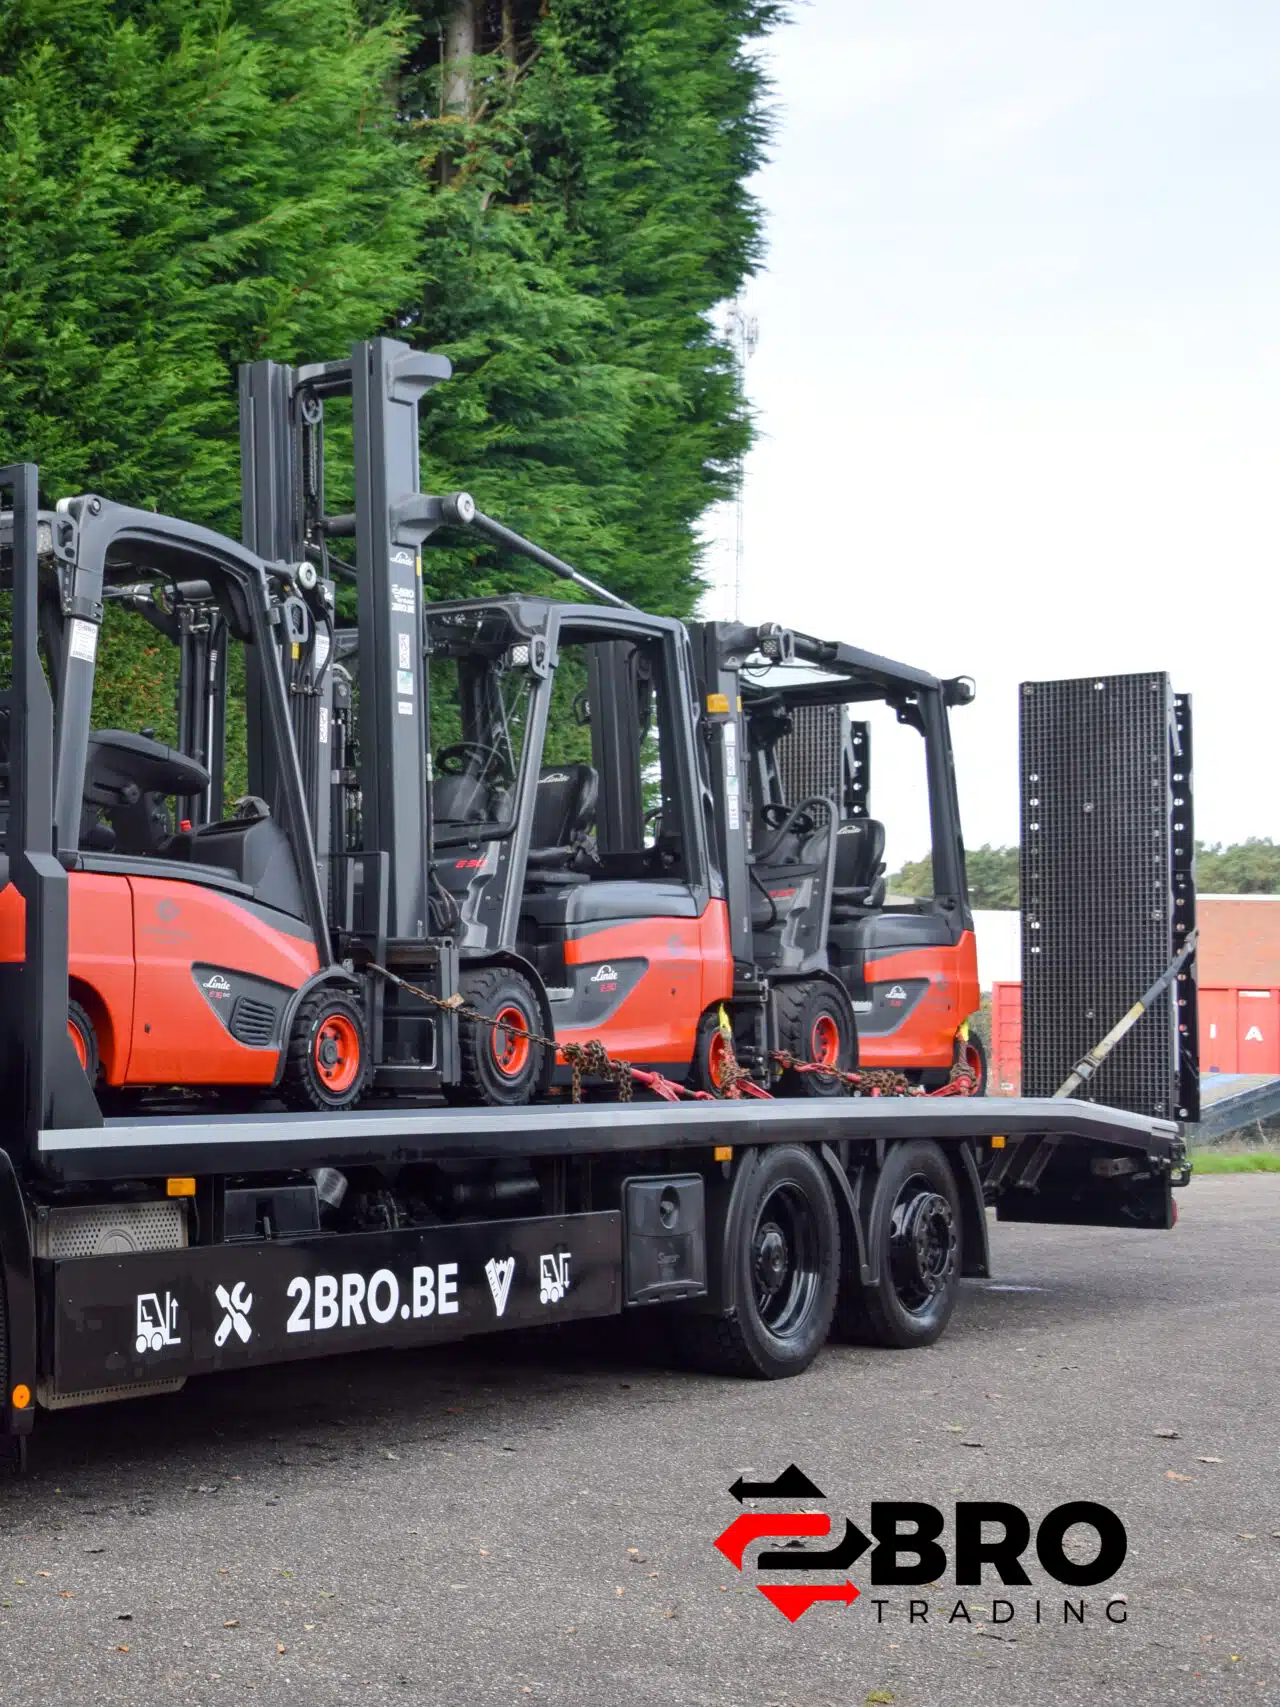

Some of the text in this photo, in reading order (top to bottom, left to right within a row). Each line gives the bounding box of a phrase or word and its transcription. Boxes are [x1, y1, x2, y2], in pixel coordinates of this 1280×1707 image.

[590, 964, 618, 982] Linde
[202, 974, 231, 990] Linde
[1244, 1025, 1264, 1041] A
[286, 1262, 459, 1333] 2BRO.BE
